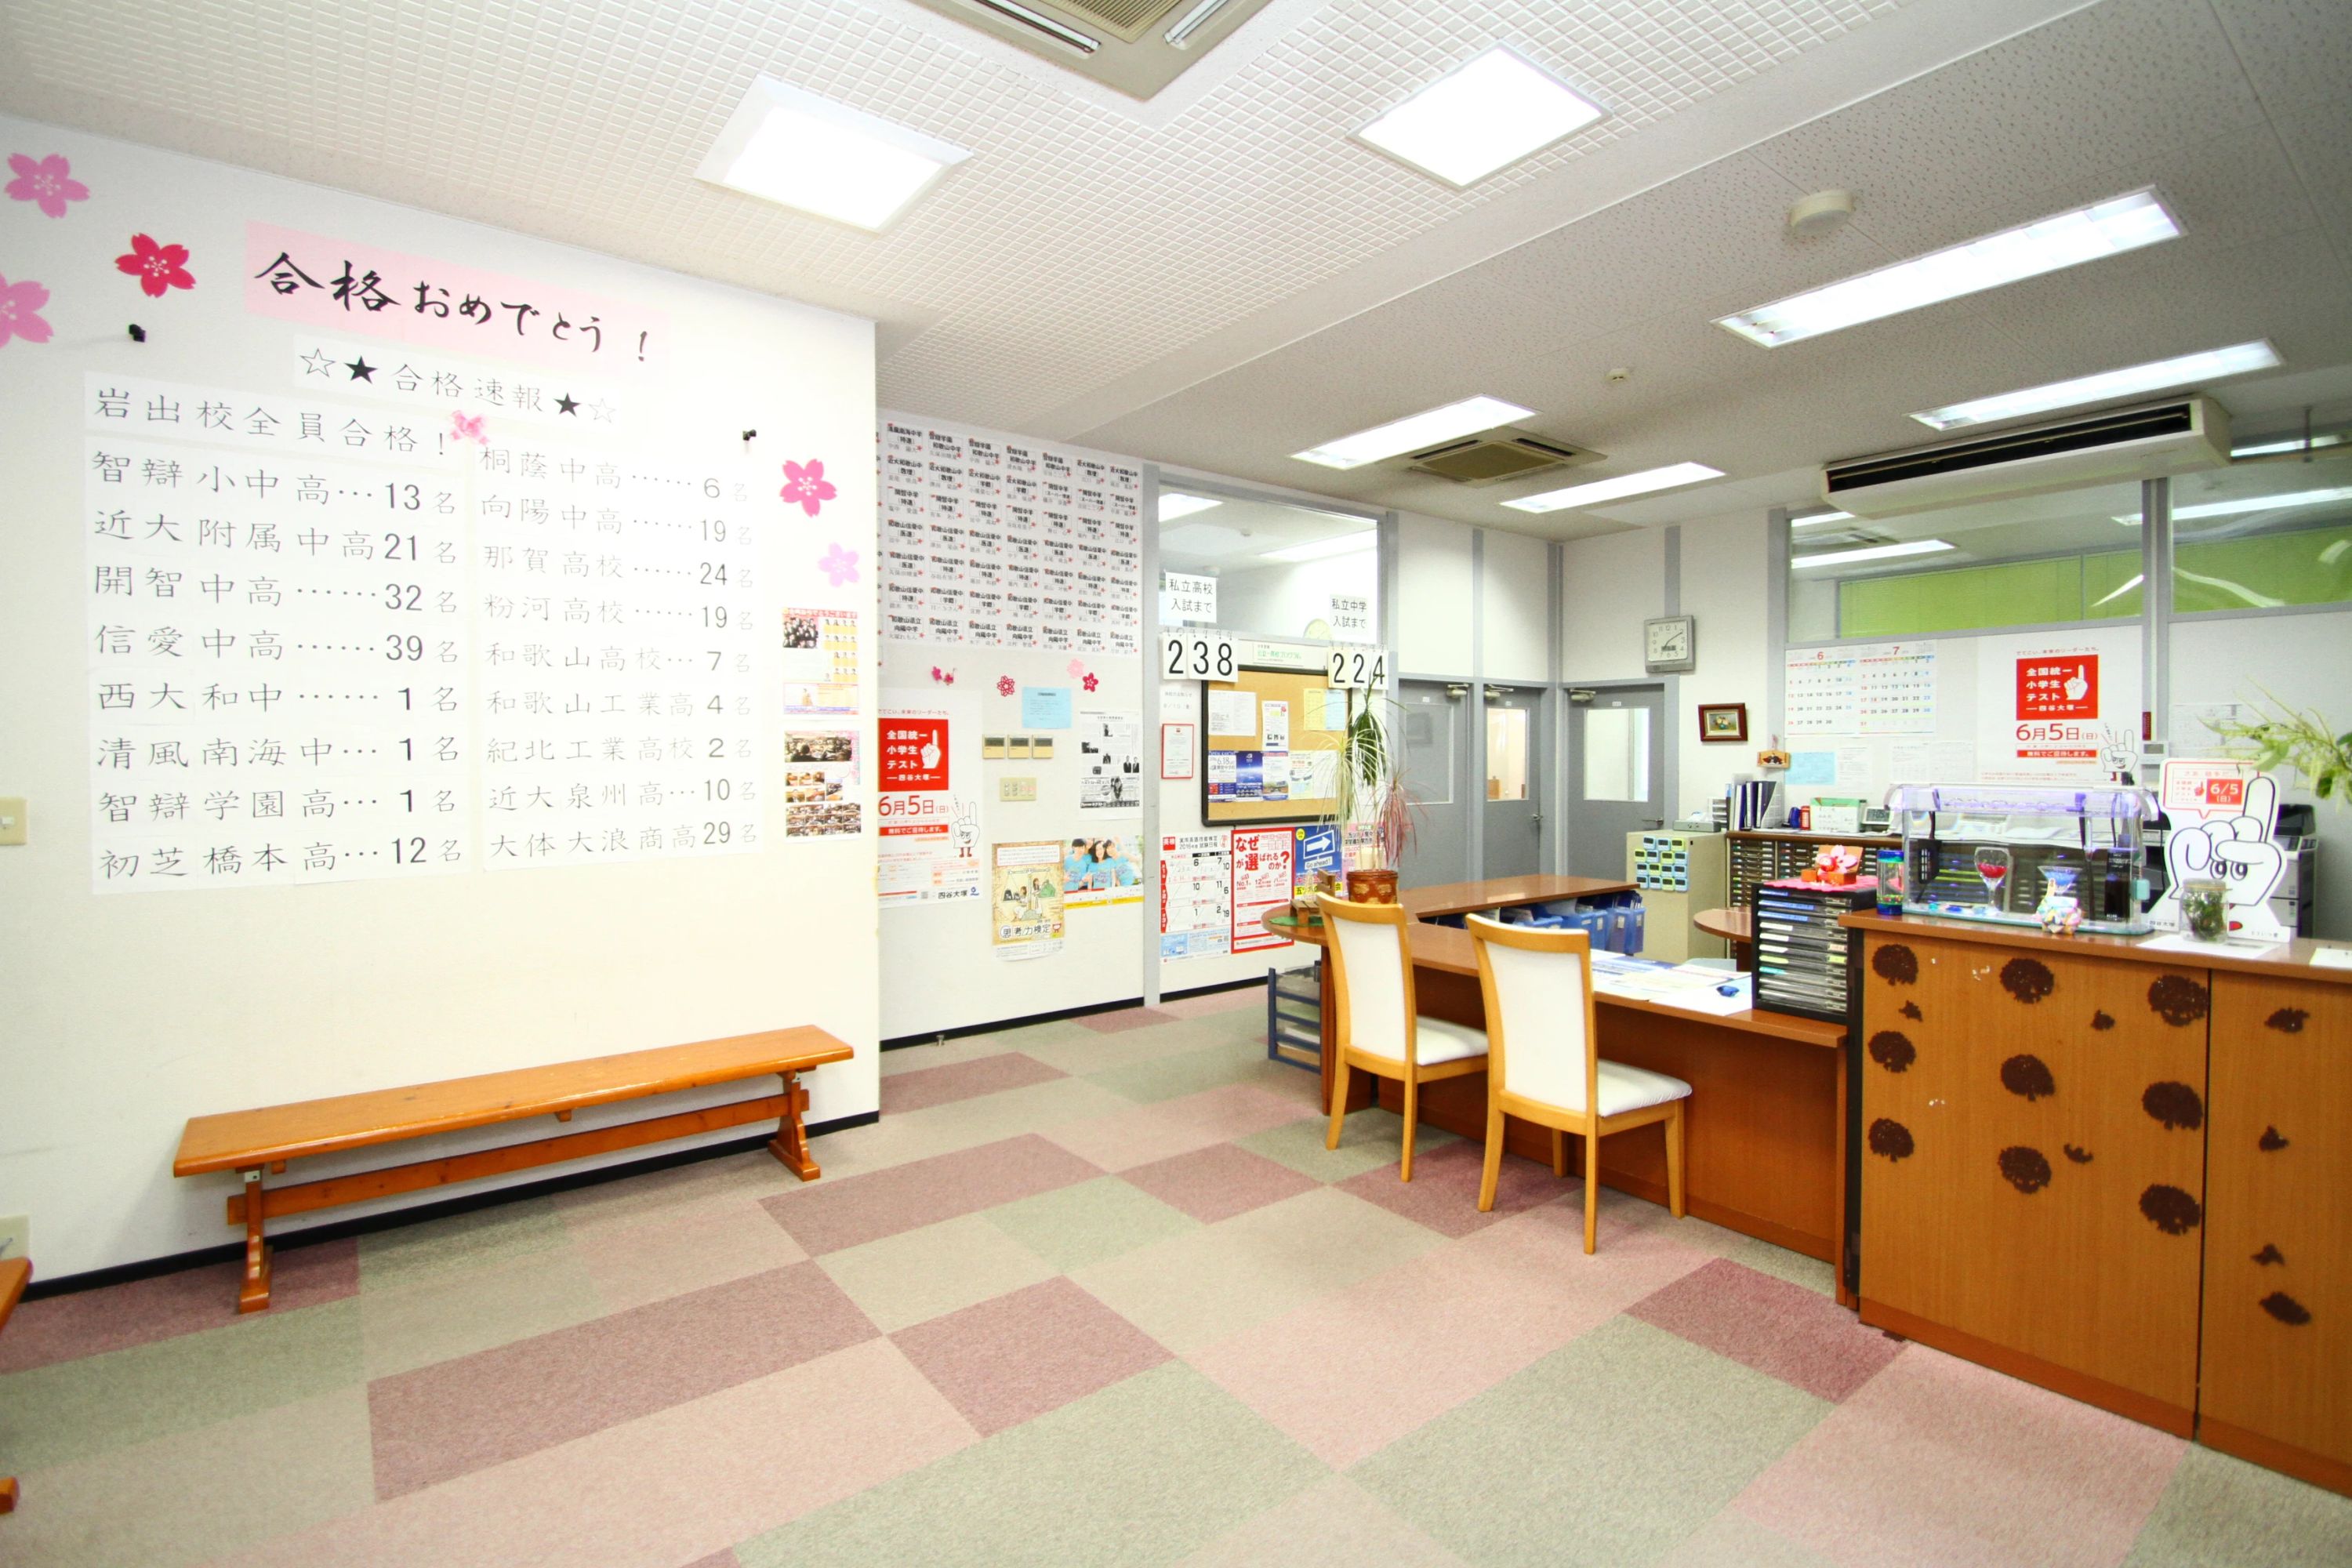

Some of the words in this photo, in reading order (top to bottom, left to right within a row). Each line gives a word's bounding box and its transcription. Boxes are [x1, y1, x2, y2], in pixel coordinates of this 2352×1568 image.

[1169, 579, 1213, 595] 私立高校
[1171, 598, 1212, 613] 入試まで
[1332, 598, 1367, 612] 私立中学
[1333, 615, 1367, 628] 入試まで
[1167, 639, 1233, 677] 238
[1333, 652, 1385, 684] 224
[2026, 666, 2072, 677] 全国統一
[2026, 680, 2061, 689] 小学生
[2026, 693, 2061, 702] テスト
[887, 729, 928, 740] 全国統一
[887, 746, 918, 755] 小学生
[887, 760, 918, 770] テスト
[2210, 783, 2239, 795] 6/5
[1236, 834, 1260, 852] なぜ
[938, 889, 967, 899] 四谷大塚
[1002, 923, 1051, 938] 思考力検定
